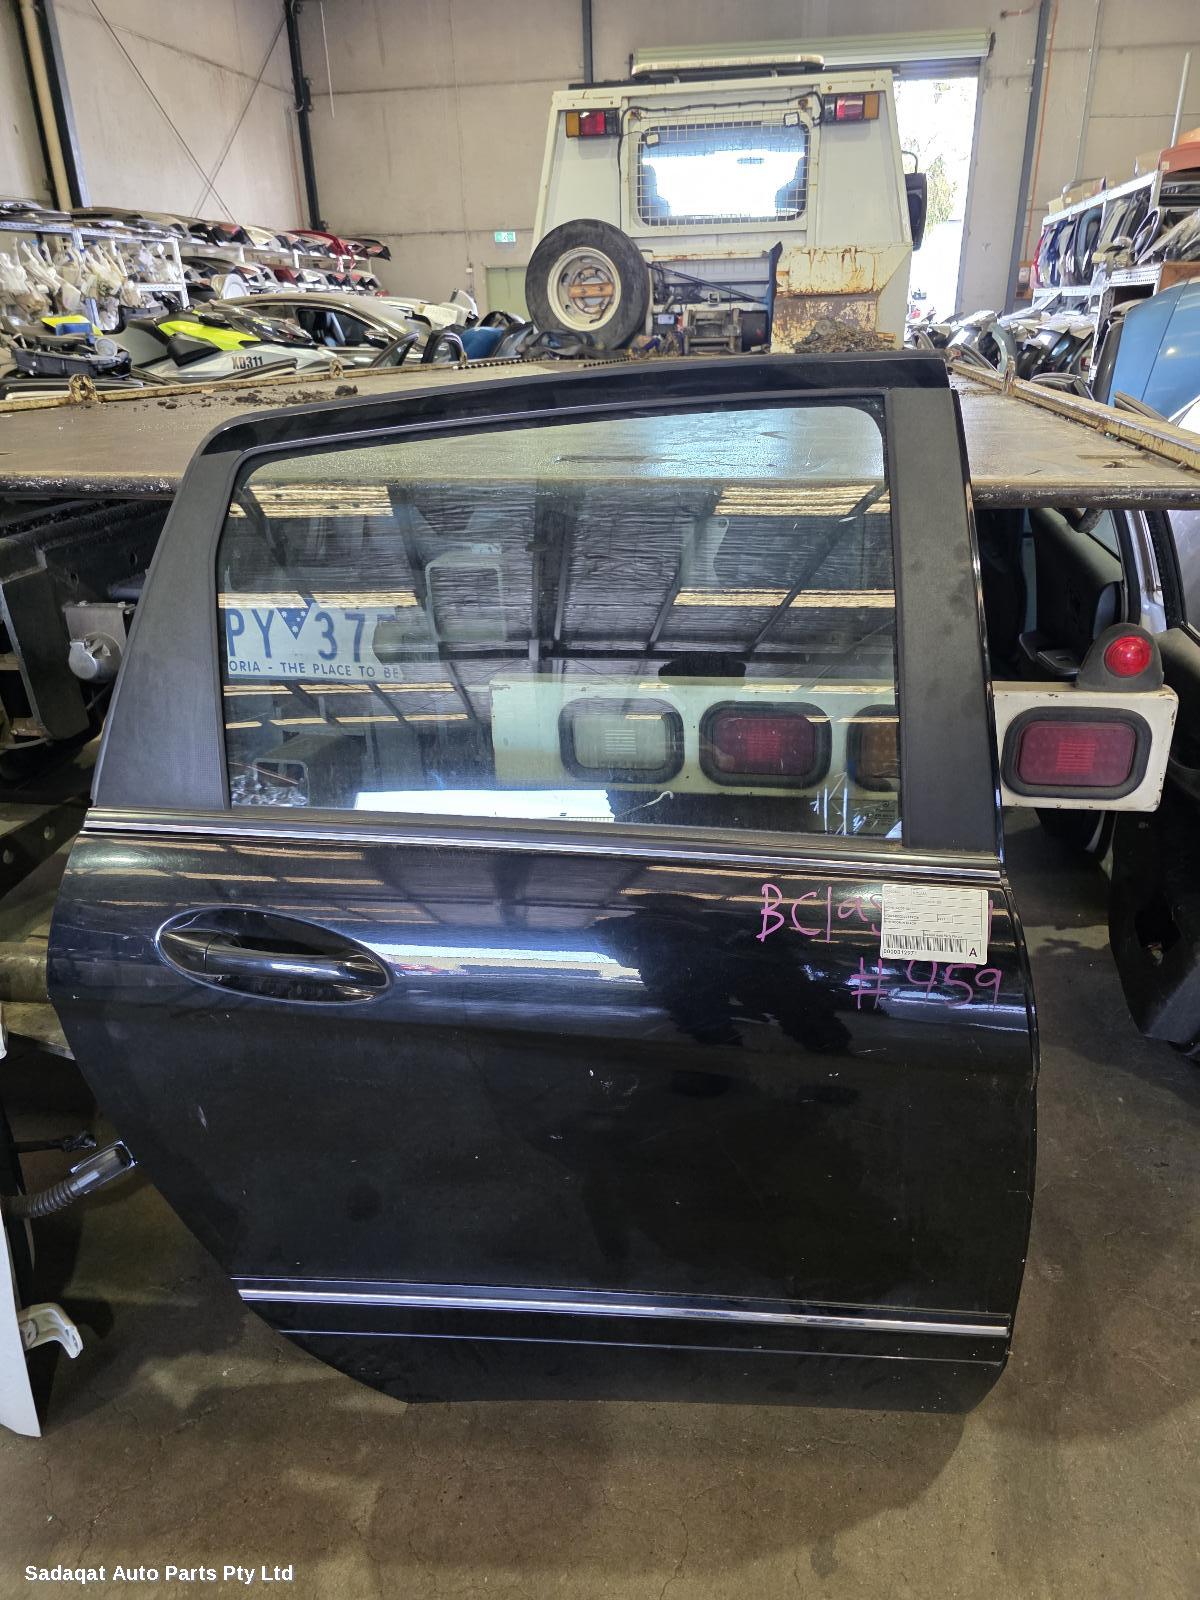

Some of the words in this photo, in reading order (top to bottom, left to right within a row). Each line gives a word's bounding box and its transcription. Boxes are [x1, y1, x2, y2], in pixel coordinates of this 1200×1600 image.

[279, 662, 306, 675] THE
[312, 664, 352, 677] PLACE
[360, 666, 376, 678] TO
[968, 947, 978, 958] A
